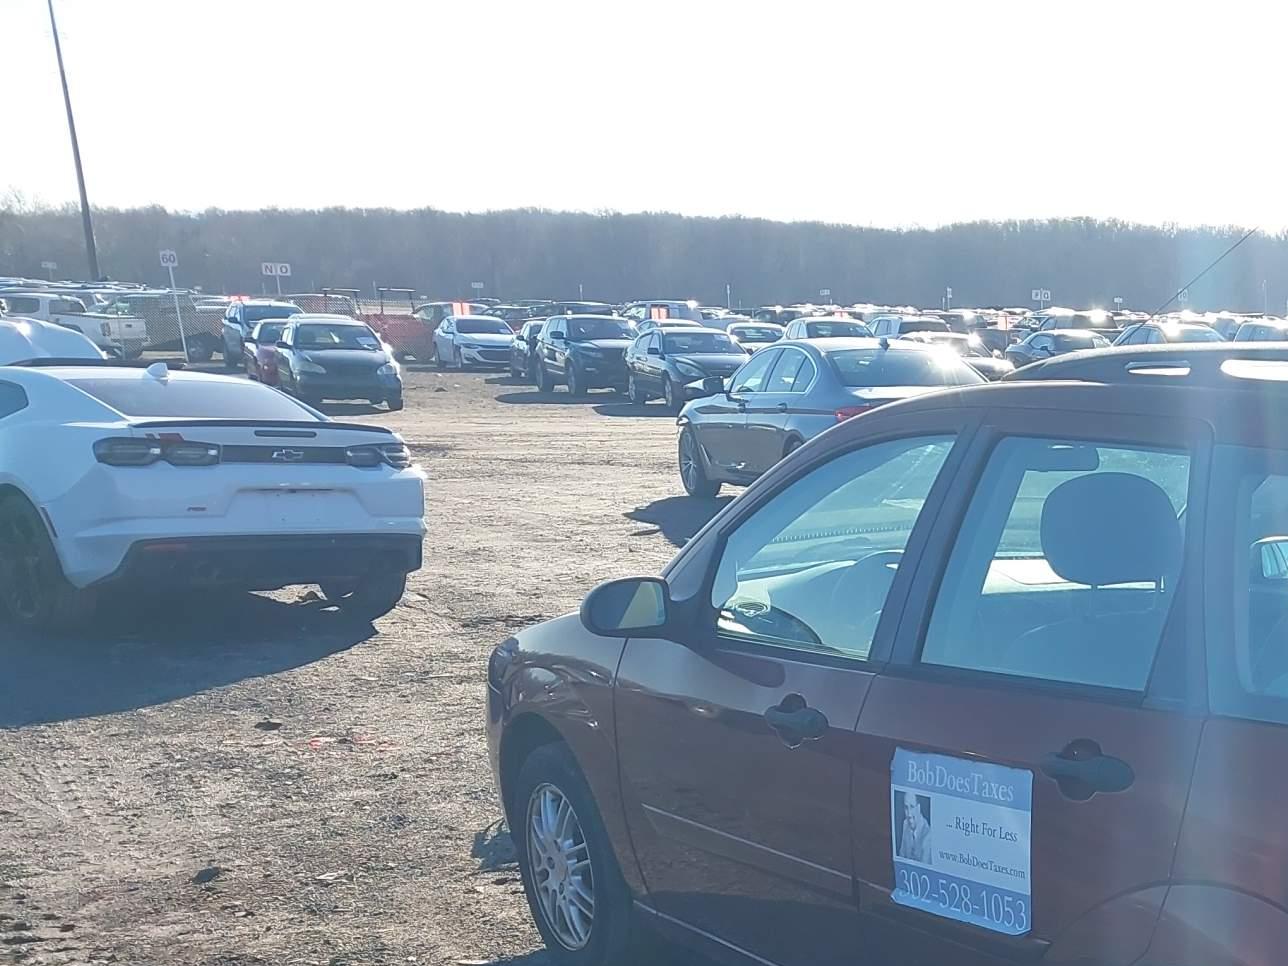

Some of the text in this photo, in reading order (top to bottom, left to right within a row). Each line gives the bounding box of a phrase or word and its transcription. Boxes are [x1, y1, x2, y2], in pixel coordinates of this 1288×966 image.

[162, 253, 176, 264] 60
[264, 265, 273, 274] N
[907, 760, 1014, 801] BobDoesTaxes
[955, 816, 980, 837] Right
[981, 822, 998, 837] For
[998, 825, 1018, 843] Less
[938, 849, 1026, 879] www.BobDoesTaxes.com
[899, 869, 1026, 930] 302-528-1053
